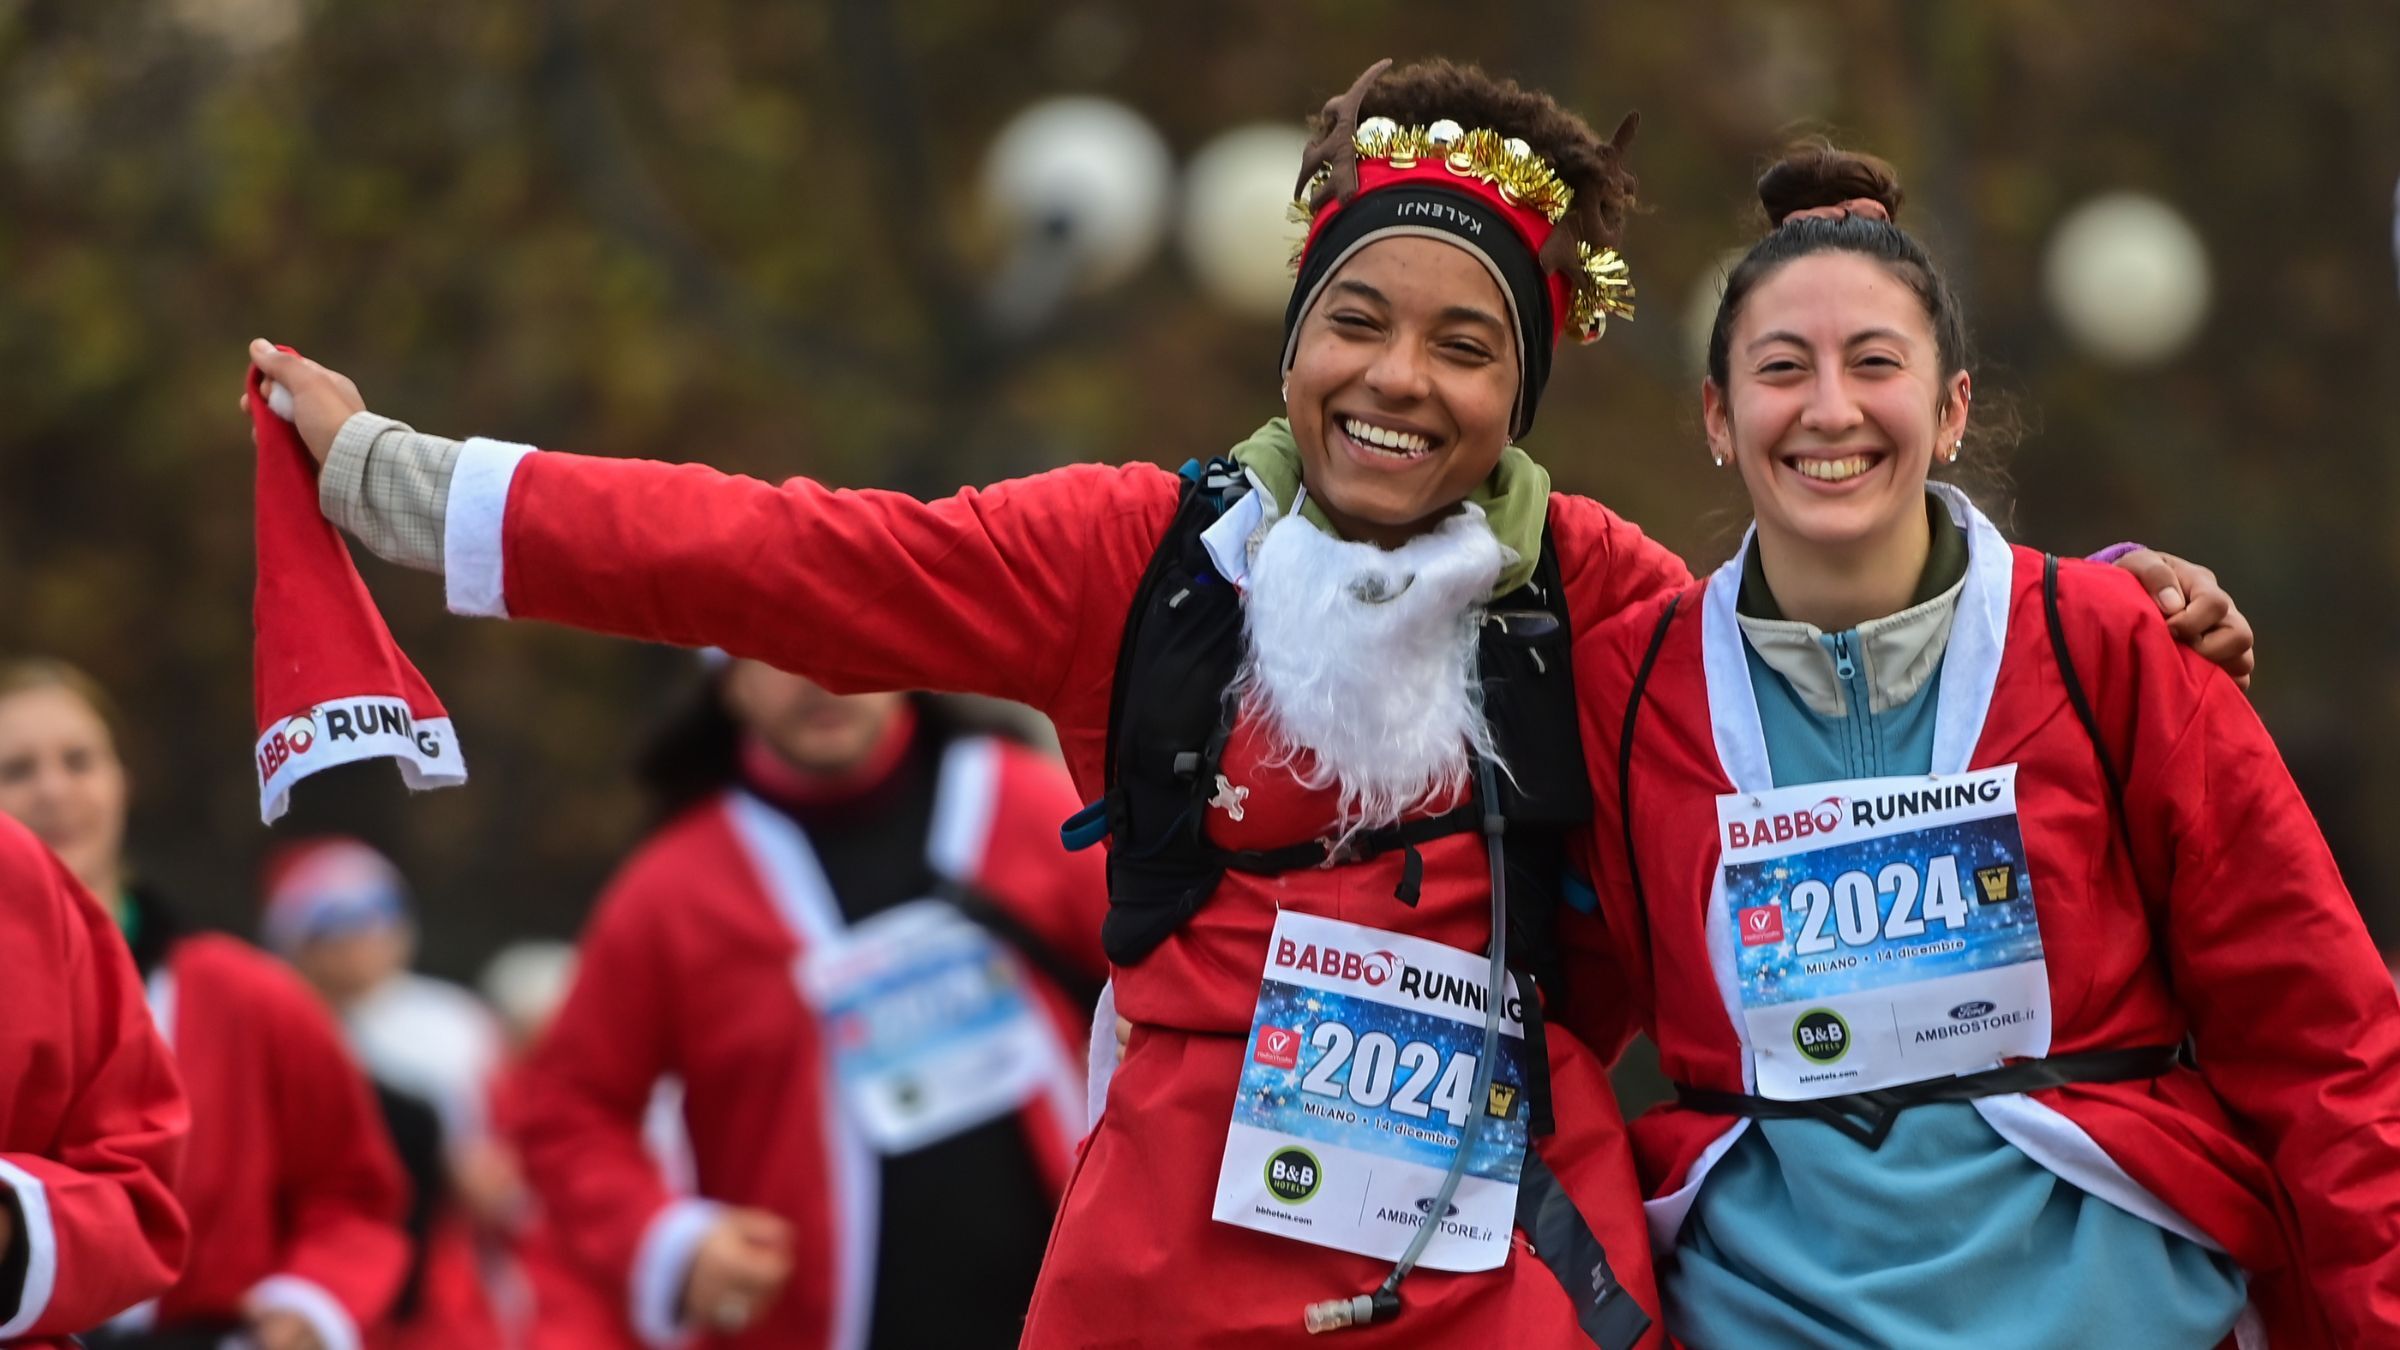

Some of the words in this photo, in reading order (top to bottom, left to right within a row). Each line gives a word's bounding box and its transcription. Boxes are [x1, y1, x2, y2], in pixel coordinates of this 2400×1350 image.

[1397, 201, 1482, 236] KALENJI
[1728, 803, 1842, 849] BABBO
[1852, 779, 2002, 828] RUNNING
[1790, 855, 1969, 956] 2024
[1805, 956, 1857, 975] MILANO
[1876, 949, 1892, 963] 14
[1897, 939, 1965, 959] dicembre
[1275, 939, 1392, 986] BABBO
[1400, 966, 1525, 1023] RUNNIG
[1799, 1022, 1843, 1045] B&B
[1915, 1009, 2035, 1043] AMBROSTORE.it
[1807, 1041, 1840, 1055] HOTELS
[1301, 1020, 1478, 1128] 2024
[1799, 1069, 1859, 1085] bbhotels.com
[1303, 1101, 1356, 1124] MILANO
[1374, 1117, 1390, 1132] 14
[1395, 1123, 1458, 1147] dicembre
[1272, 1159, 1314, 1187] B&B
[1273, 1179, 1307, 1194] HOTELS
[1255, 1205, 1313, 1226] bbhotels.com
[1376, 1206, 1492, 1242] AMBROTORE.it
